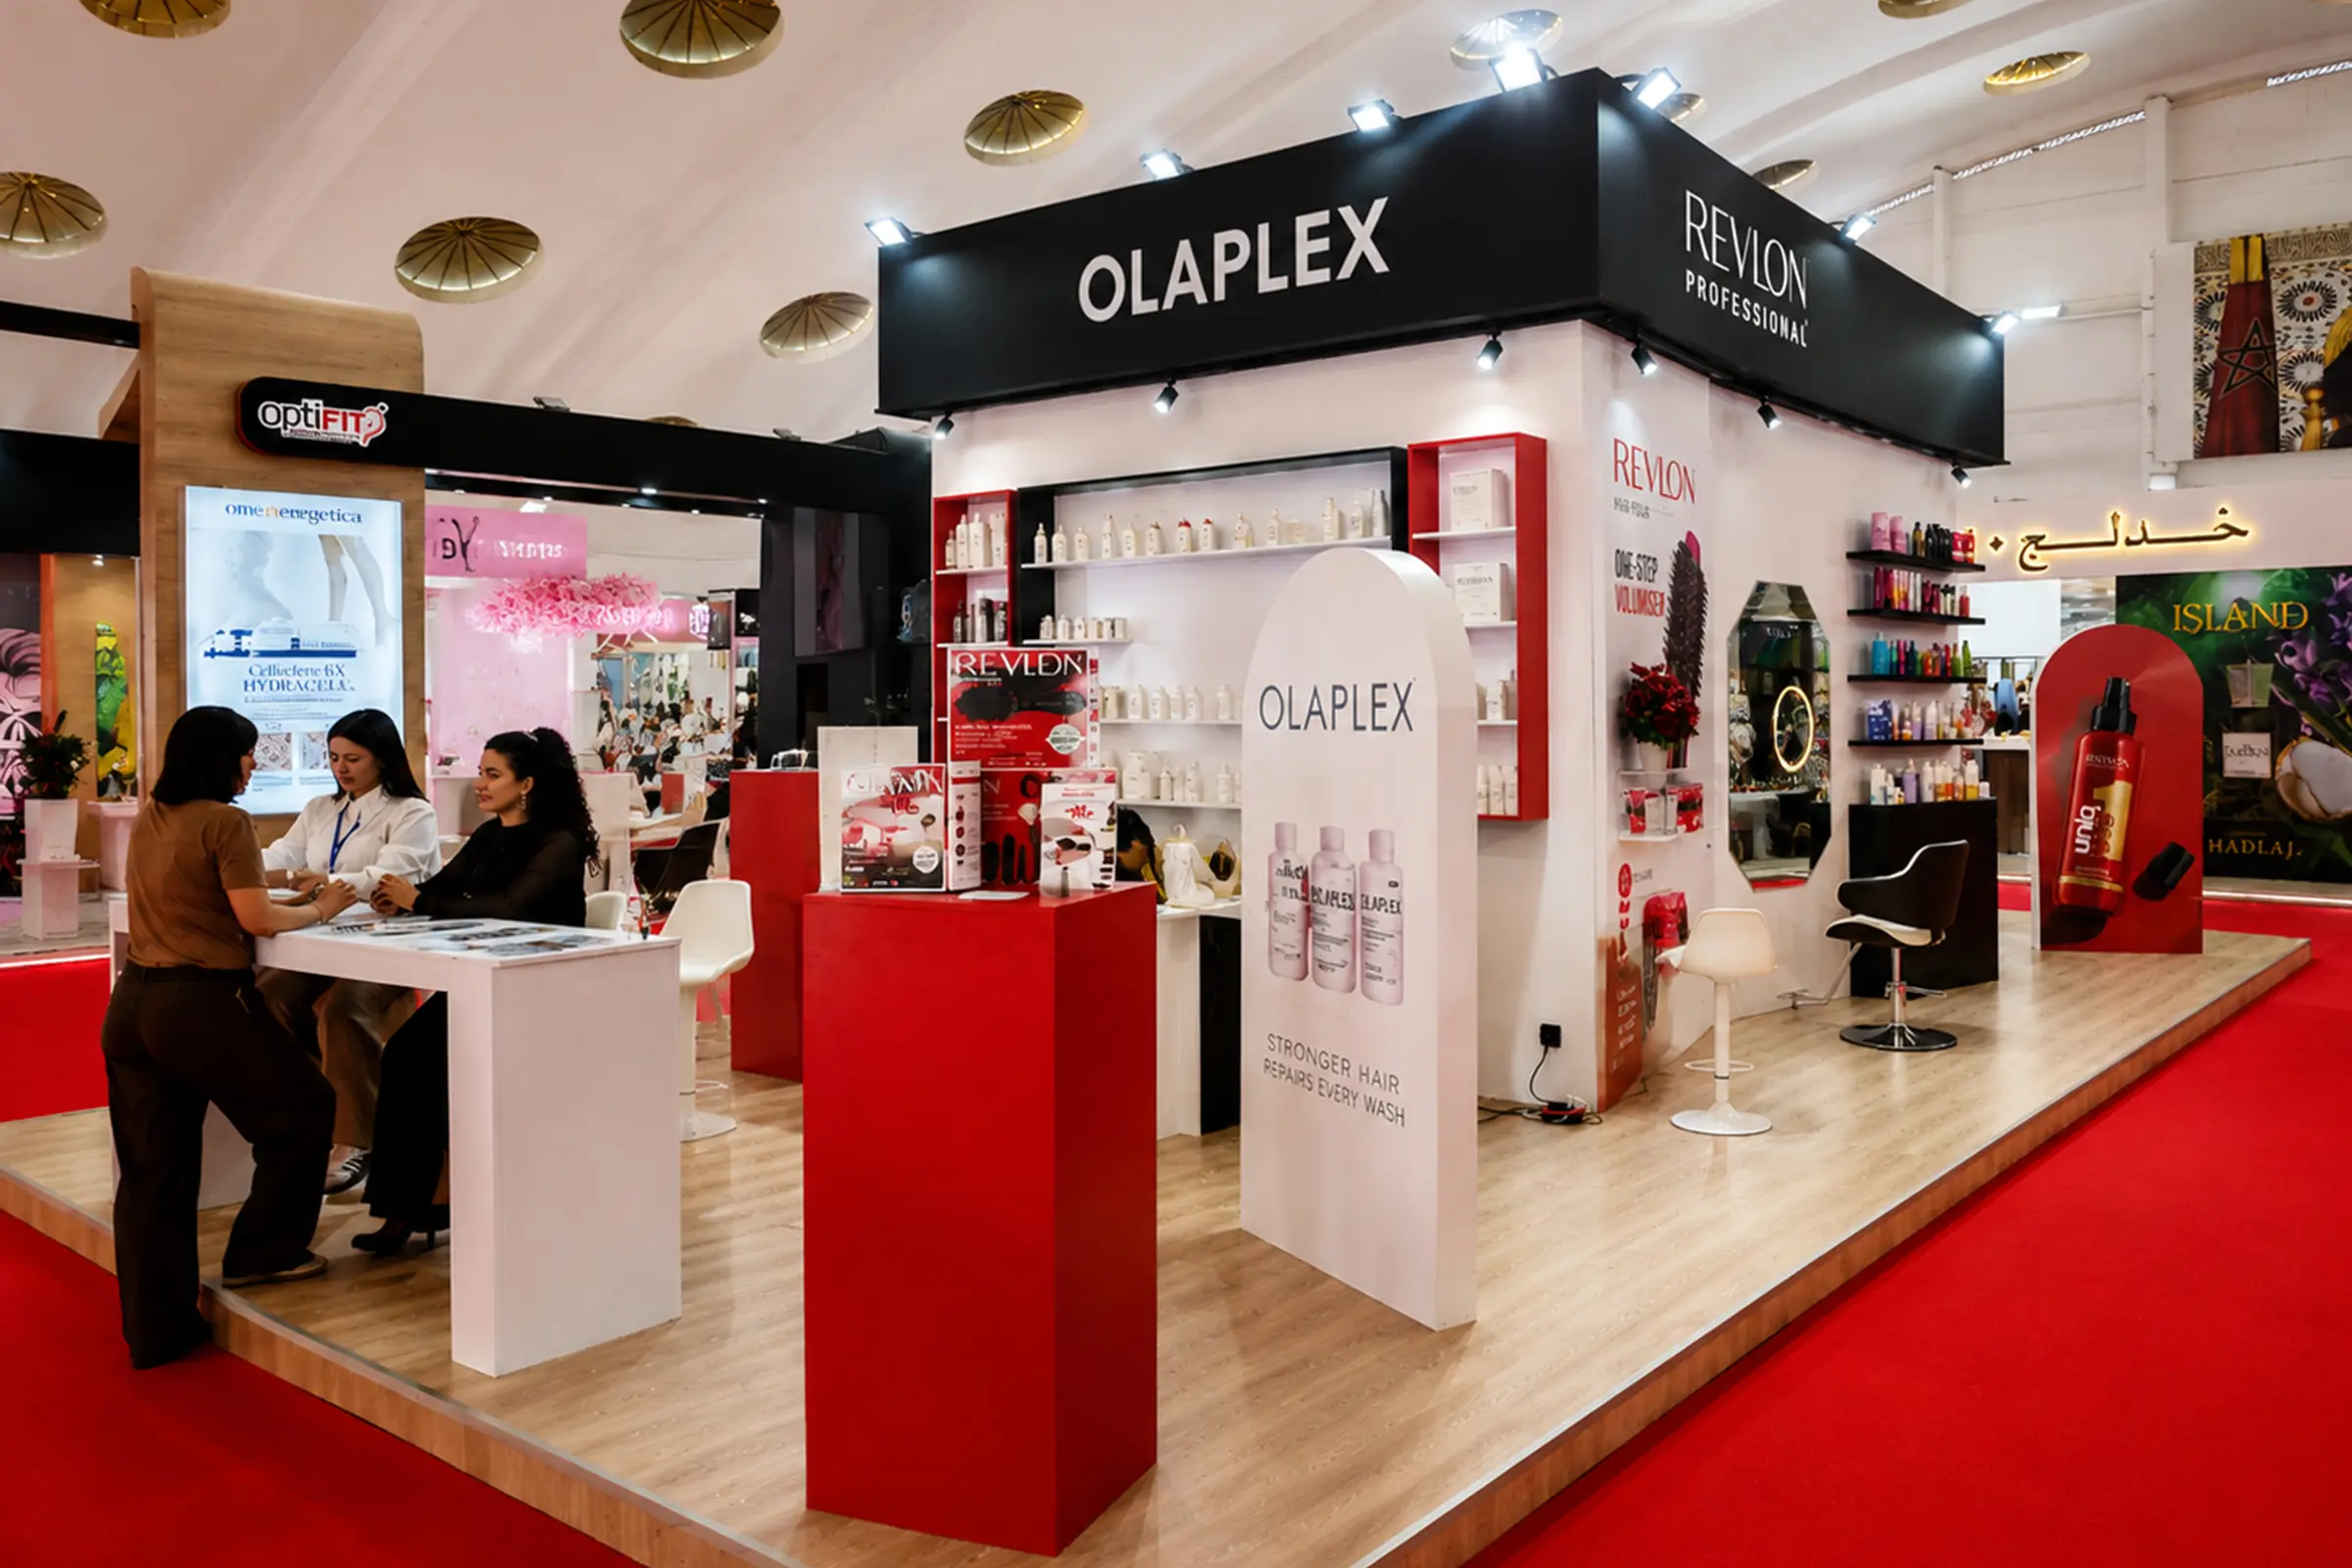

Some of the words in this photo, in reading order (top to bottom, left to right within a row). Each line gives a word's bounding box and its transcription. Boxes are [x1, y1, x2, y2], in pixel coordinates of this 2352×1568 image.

[1078, 196, 1390, 322] OLAPLEX
[1686, 189, 1807, 310] REVLON
[1685, 268, 1808, 348] PROFESSIONAL
[1613, 437, 1695, 506] REVLON
[2172, 600, 2310, 635] ISLAND
[1258, 681, 1414, 732] OLAPLEX
[1262, 1056, 1314, 1093] REPAIRS
[1317, 1076, 1360, 1109] EVERY
[1363, 1093, 1406, 1128] WASH
[1266, 1032, 1351, 1078] STRONGER
[1358, 1063, 1400, 1096] HAIR
